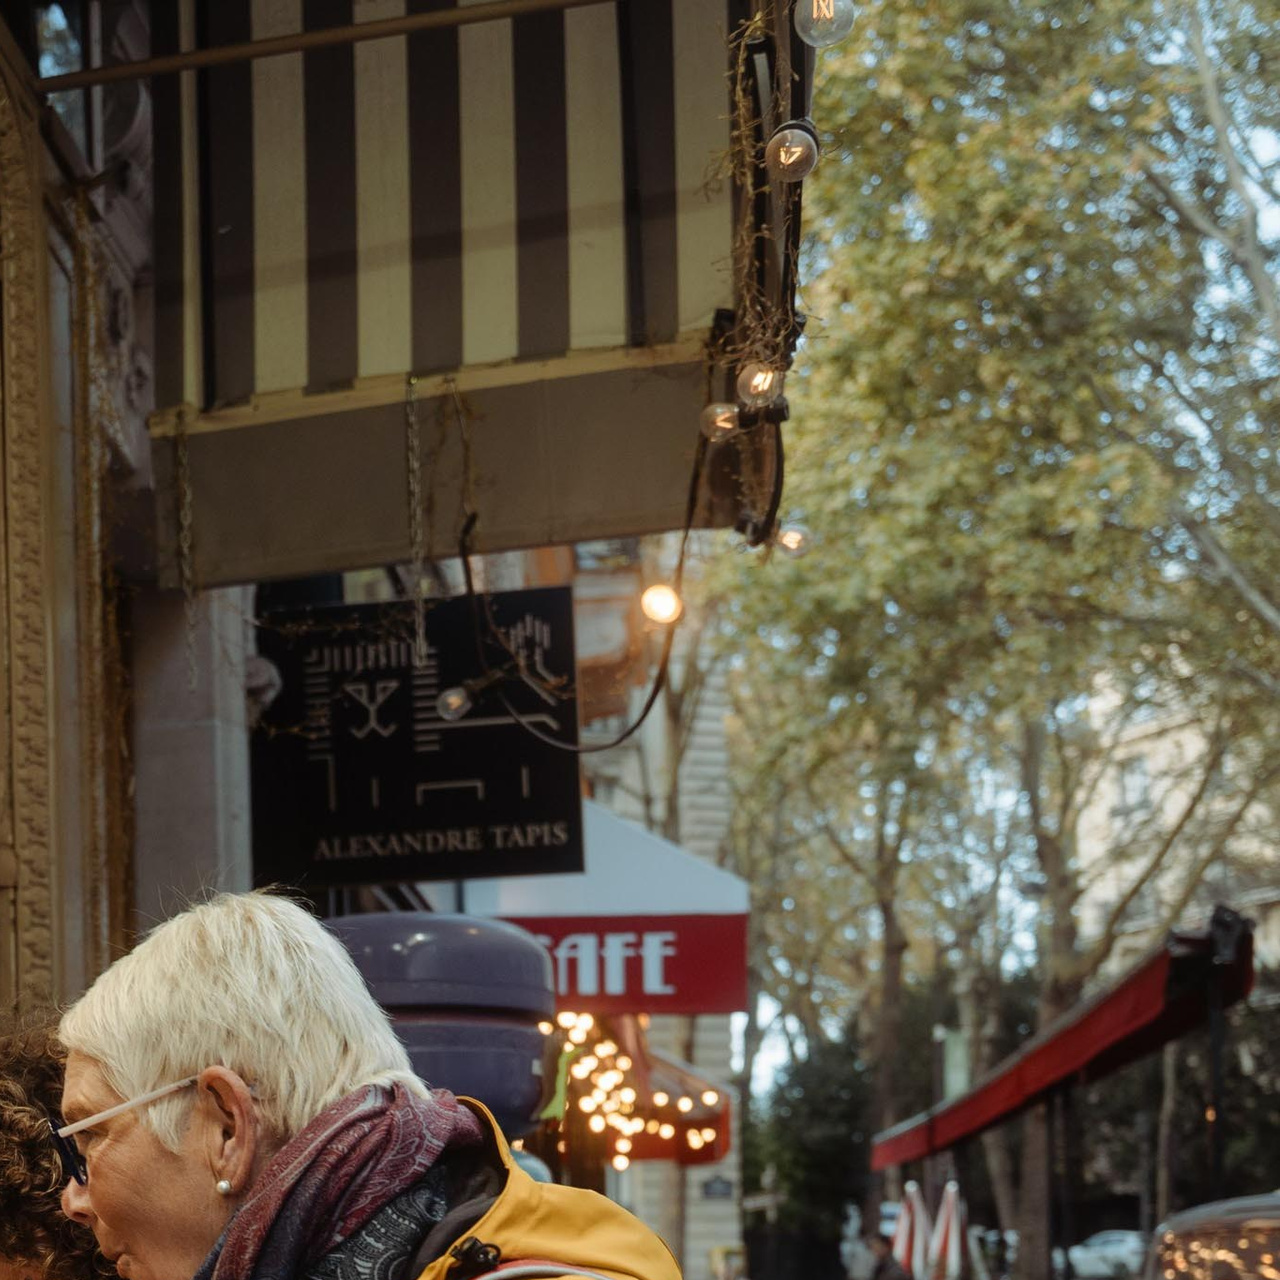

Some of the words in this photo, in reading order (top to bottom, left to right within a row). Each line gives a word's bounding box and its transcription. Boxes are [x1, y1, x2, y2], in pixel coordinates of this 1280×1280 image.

[316, 826, 483, 861] ALEXANDRE
[491, 822, 569, 849] TAPIS
[535, 931, 677, 996] AFE
